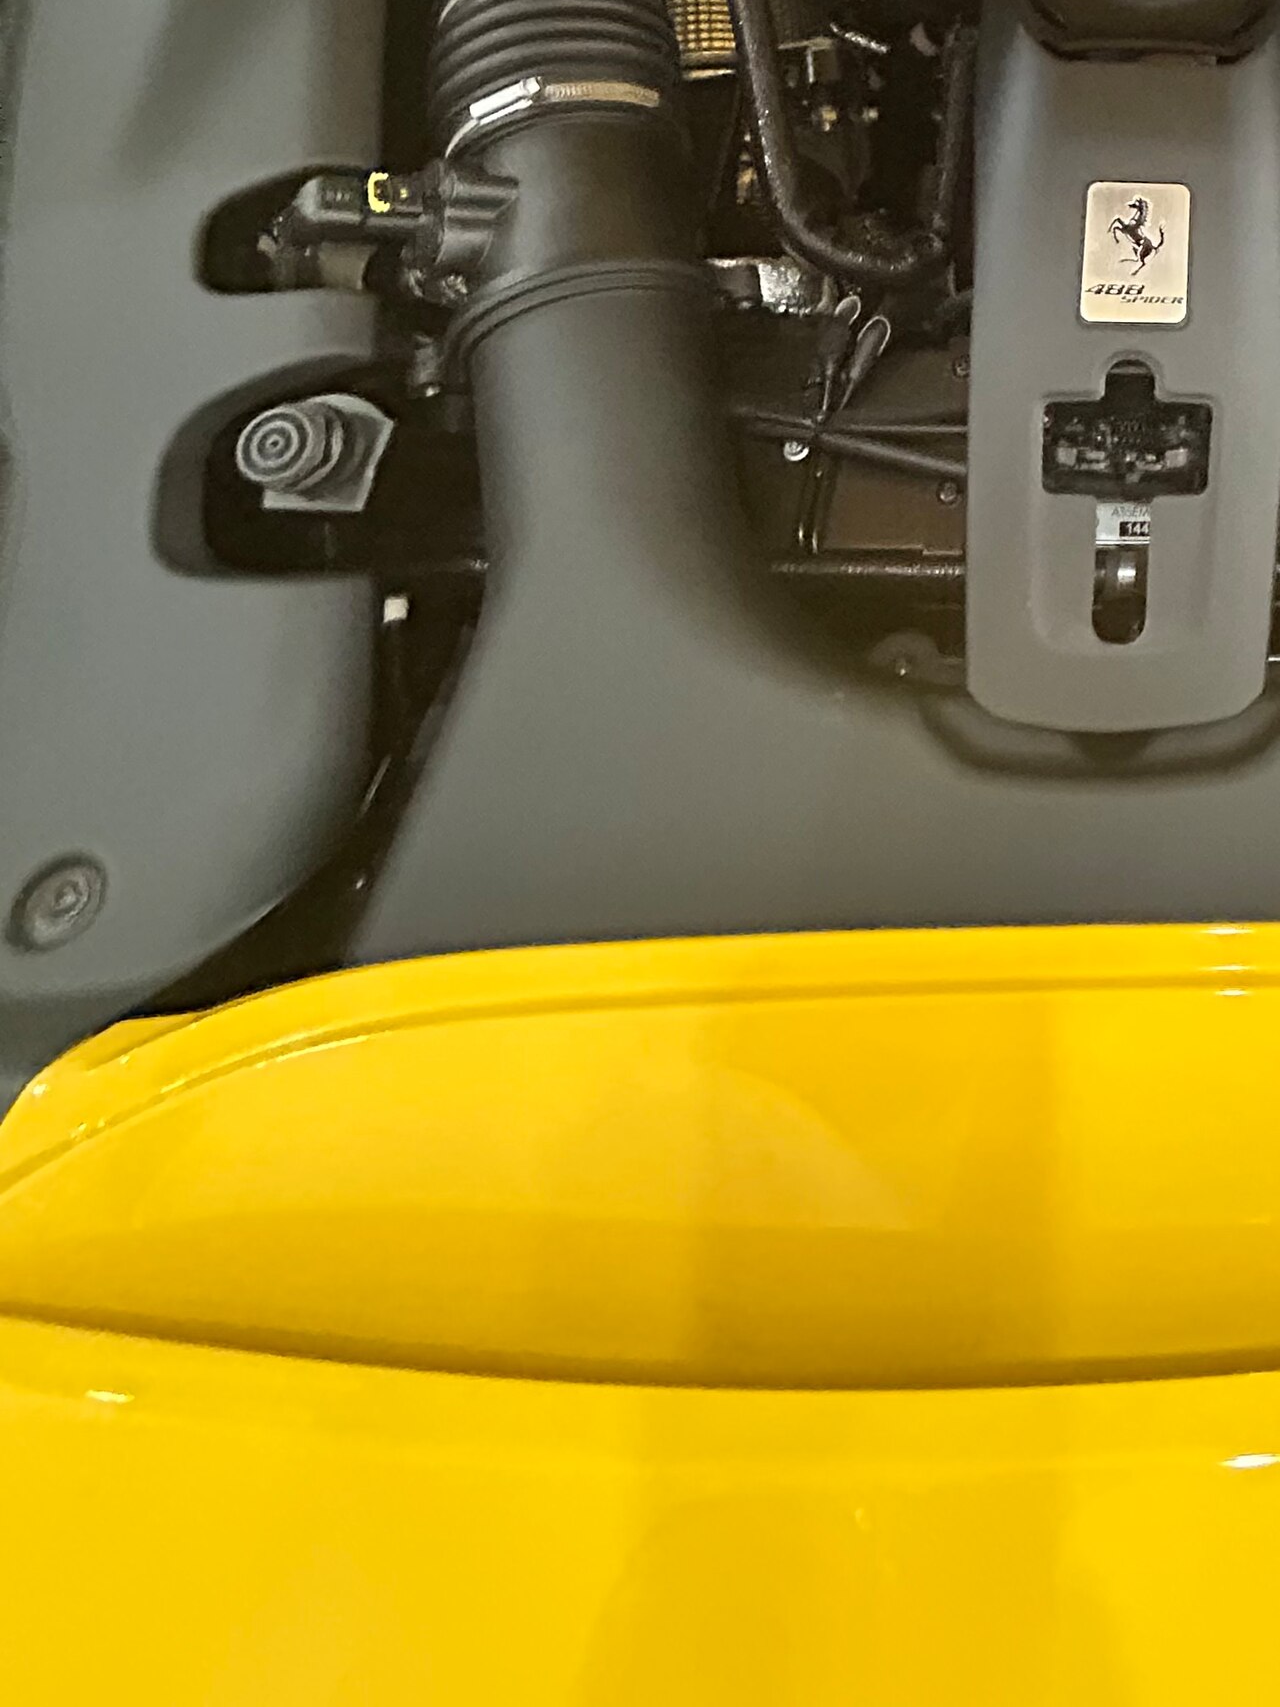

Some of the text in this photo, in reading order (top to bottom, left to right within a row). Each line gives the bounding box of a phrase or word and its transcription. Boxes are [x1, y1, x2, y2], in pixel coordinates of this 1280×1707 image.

[1085, 282, 1146, 296] 488
[1120, 295, 1184, 305] SPIDER
[1126, 522, 1150, 535] 144
